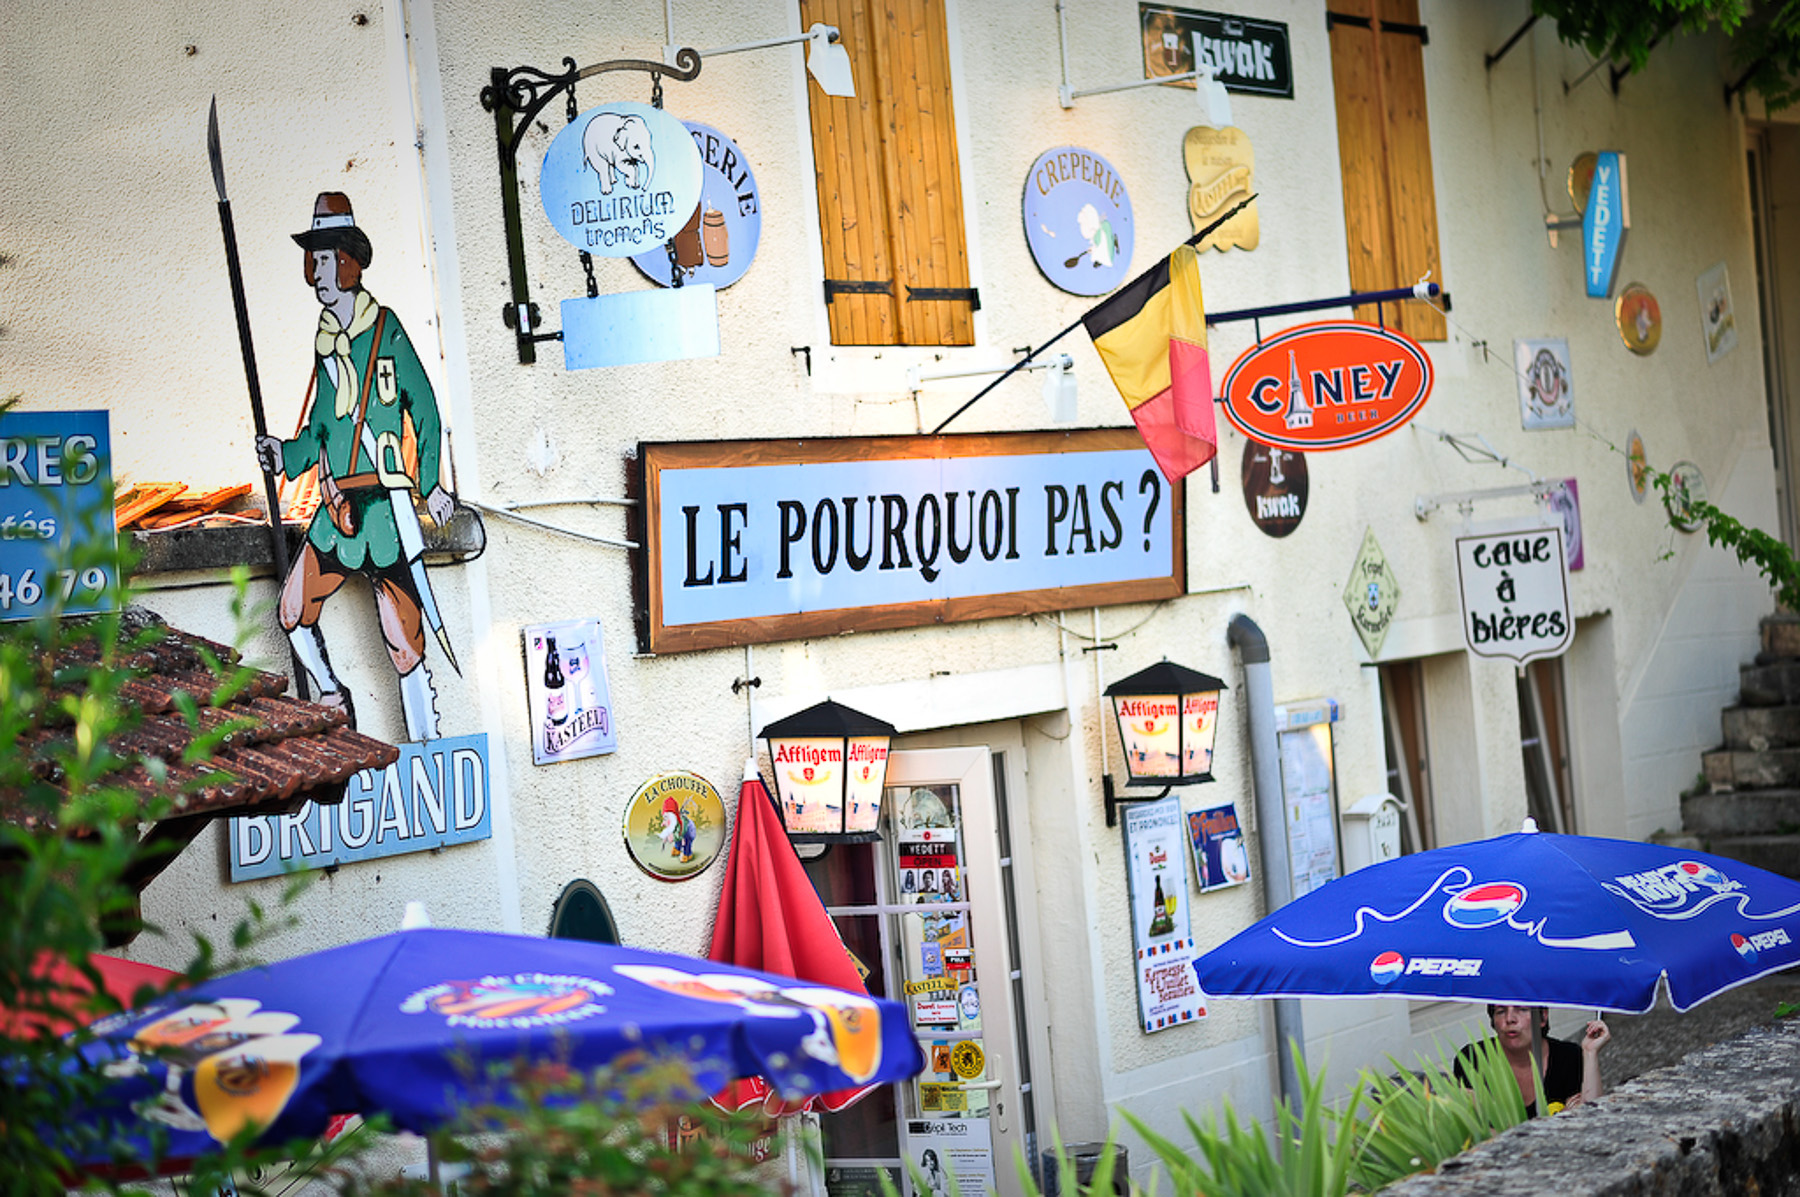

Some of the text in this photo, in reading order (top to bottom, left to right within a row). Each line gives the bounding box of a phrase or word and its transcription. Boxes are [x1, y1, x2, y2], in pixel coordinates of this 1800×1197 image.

[1036, 152, 1124, 208] CREPERIE
[570, 191, 675, 226] DELIRIUM
[585, 218, 666, 248] tremens
[1590, 165, 1611, 285] VEDETT
[1336, 410, 1379, 424] BEER
[682, 502, 748, 587] LE
[776, 486, 1020, 583] POURQUOI
[1496, 570, 1517, 602] à
[1471, 607, 1567, 644] bières
[1119, 700, 1178, 719] Affligem
[546, 708, 604, 748] KASTEEL
[774, 743, 842, 766] Affligem
[644, 775, 709, 804] LA CHOUFFE
[237, 748, 486, 867] BRIGAND
[914, 857, 942, 867] OPEN
[1749, 928, 1792, 952] PEPSI
[1404, 957, 1483, 976] PEPSI
[947, 1122, 968, 1134] Tech
